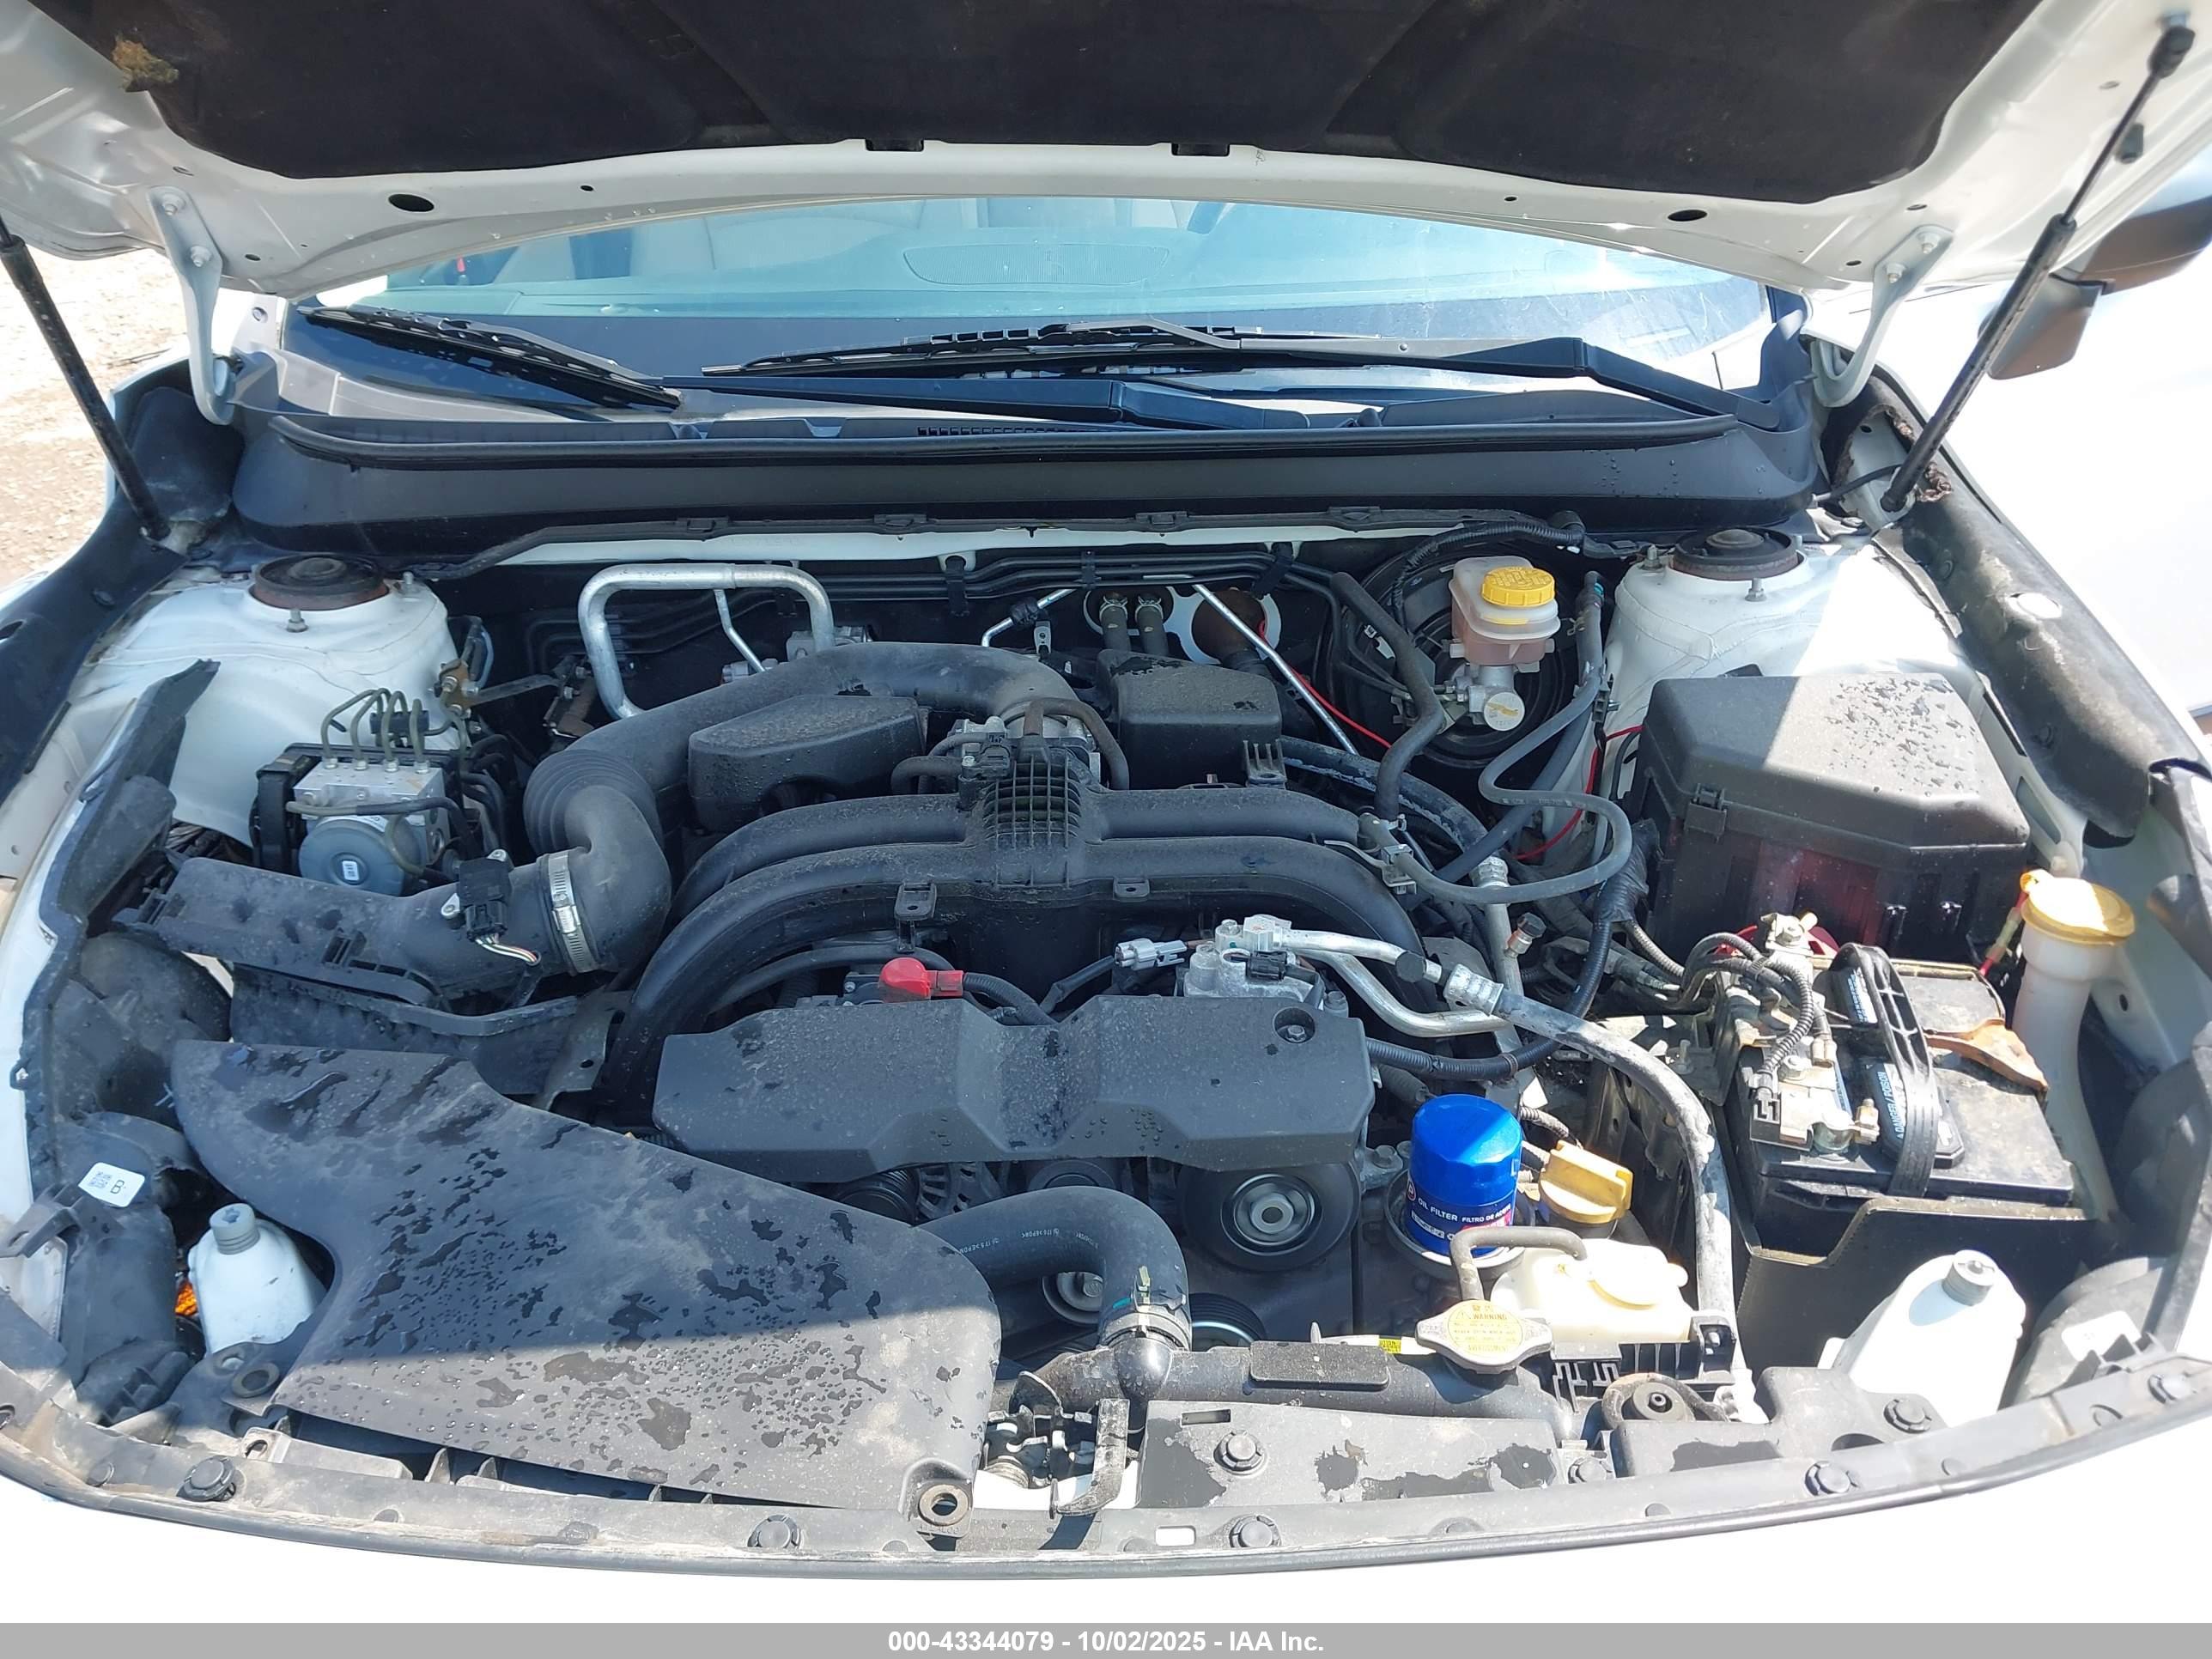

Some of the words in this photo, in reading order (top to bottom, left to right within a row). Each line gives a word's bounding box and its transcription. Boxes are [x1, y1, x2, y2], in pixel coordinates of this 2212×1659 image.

[1877, 1072, 1893, 1097] POISON
[1887, 1103, 1905, 1133] DANGER
[1418, 1198, 1429, 1210] OIL
[1430, 1206, 1458, 1222] FILTER
